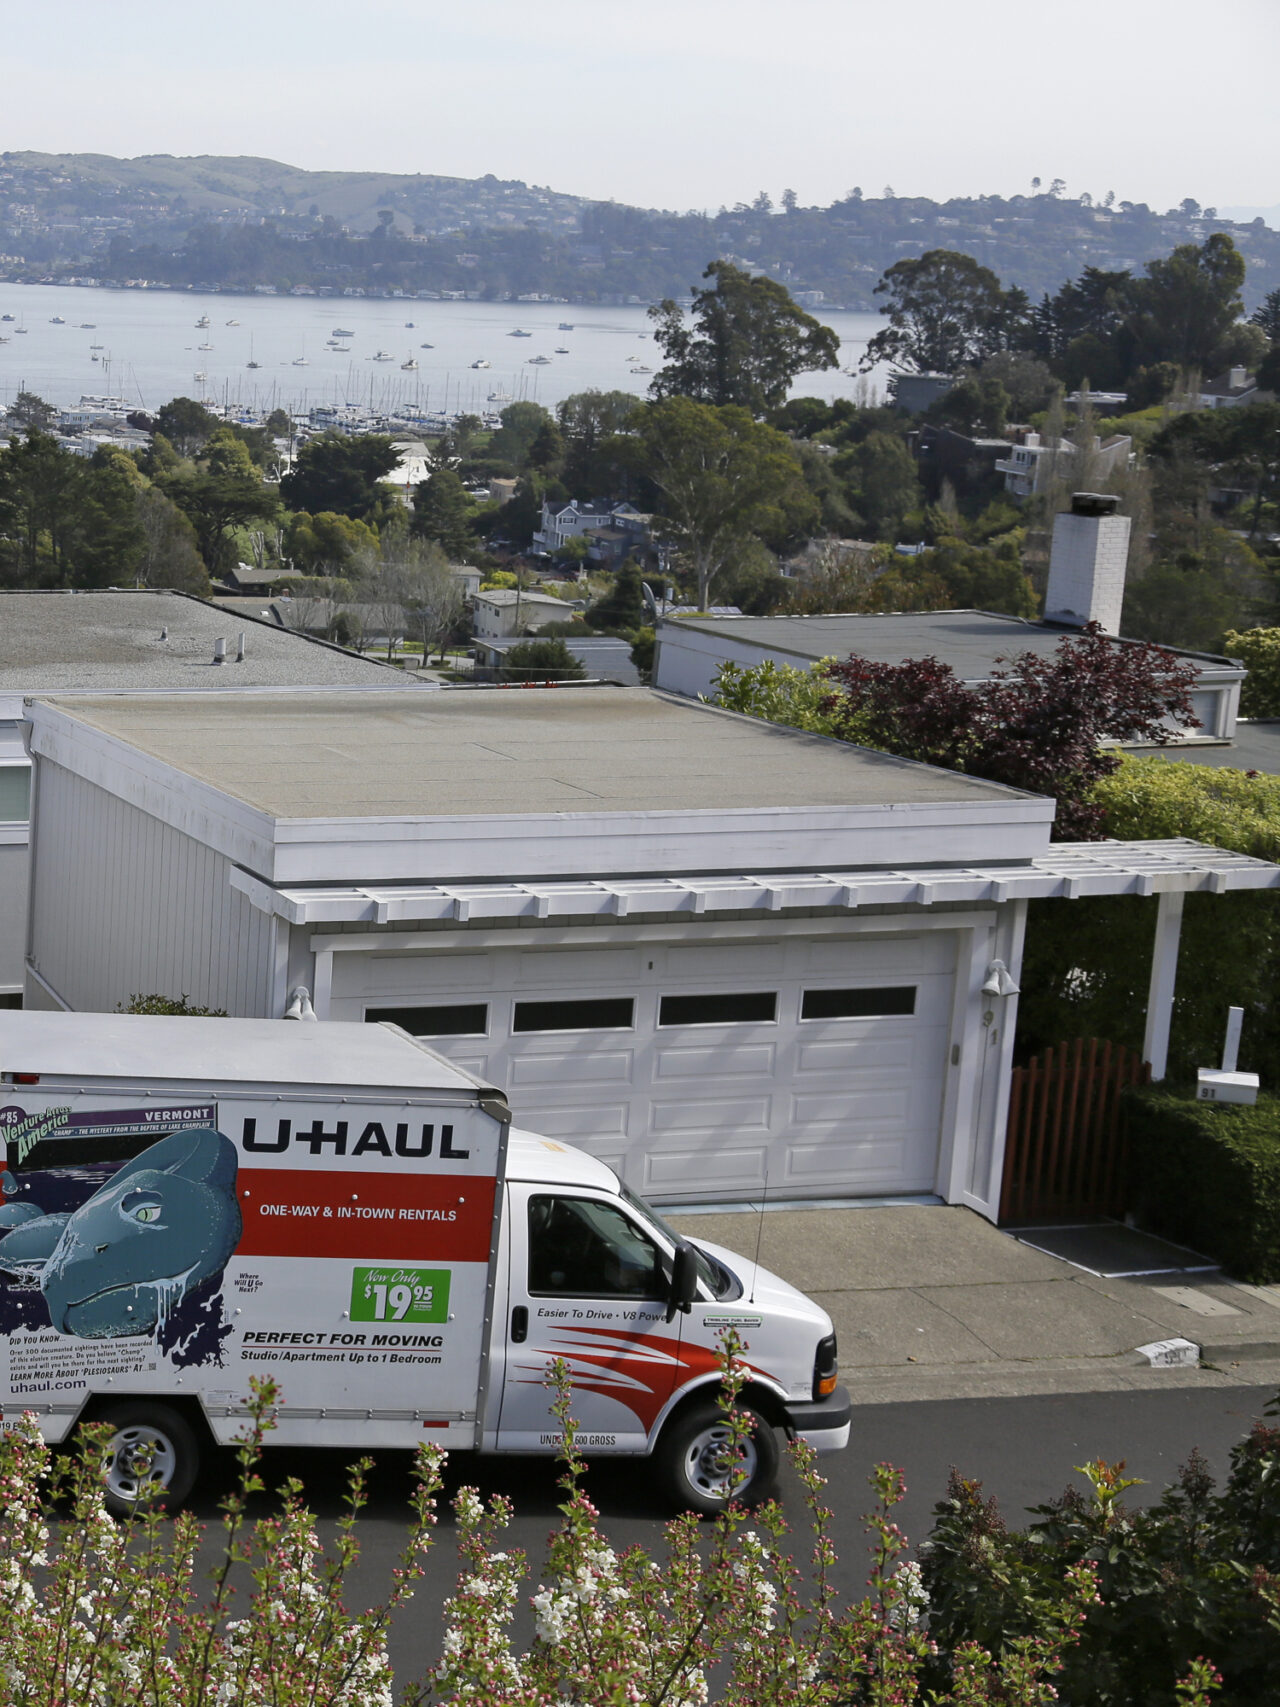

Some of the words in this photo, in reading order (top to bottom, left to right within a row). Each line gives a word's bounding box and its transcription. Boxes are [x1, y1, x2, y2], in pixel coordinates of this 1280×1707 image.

[1201, 1087, 1215, 1098] 91
[0, 1111, 18, 1124] #85
[145, 1108, 210, 1122] VERMONT
[1, 1112, 45, 1144] Venture
[90, 1127, 113, 1135] MYSTERY
[18, 1115, 68, 1165] America
[242, 1117, 470, 1160] U-HAUL
[259, 1204, 320, 1217] ONE-WAY
[322, 1206, 333, 1218] &
[337, 1207, 395, 1219] IN-TOWN
[398, 1209, 457, 1222] RENTALS
[239, 1272, 259, 1280] Where
[247, 1279, 254, 1287] U
[364, 1269, 389, 1282] Now
[391, 1269, 421, 1287] Only
[538, 1307, 569, 1318] Easier
[572, 1309, 583, 1318] To
[586, 1309, 613, 1320] Drive
[623, 1311, 636, 1320] V8
[638, 1312, 668, 1321] Powe
[242, 1331, 327, 1345] PERFECT
[329, 1333, 366, 1345] FOR
[371, 1335, 443, 1347] MOVING
[240, 1350, 345, 1363] Studio/Apartment
[349, 1352, 364, 1363] Up
[367, 1353, 377, 1362] to
[381, 1353, 386, 1362] 1
[390, 1354, 442, 1364] Bedroom
[11, 1380, 87, 1393] uhaul.com
[589, 1435, 616, 1445] GROSS
